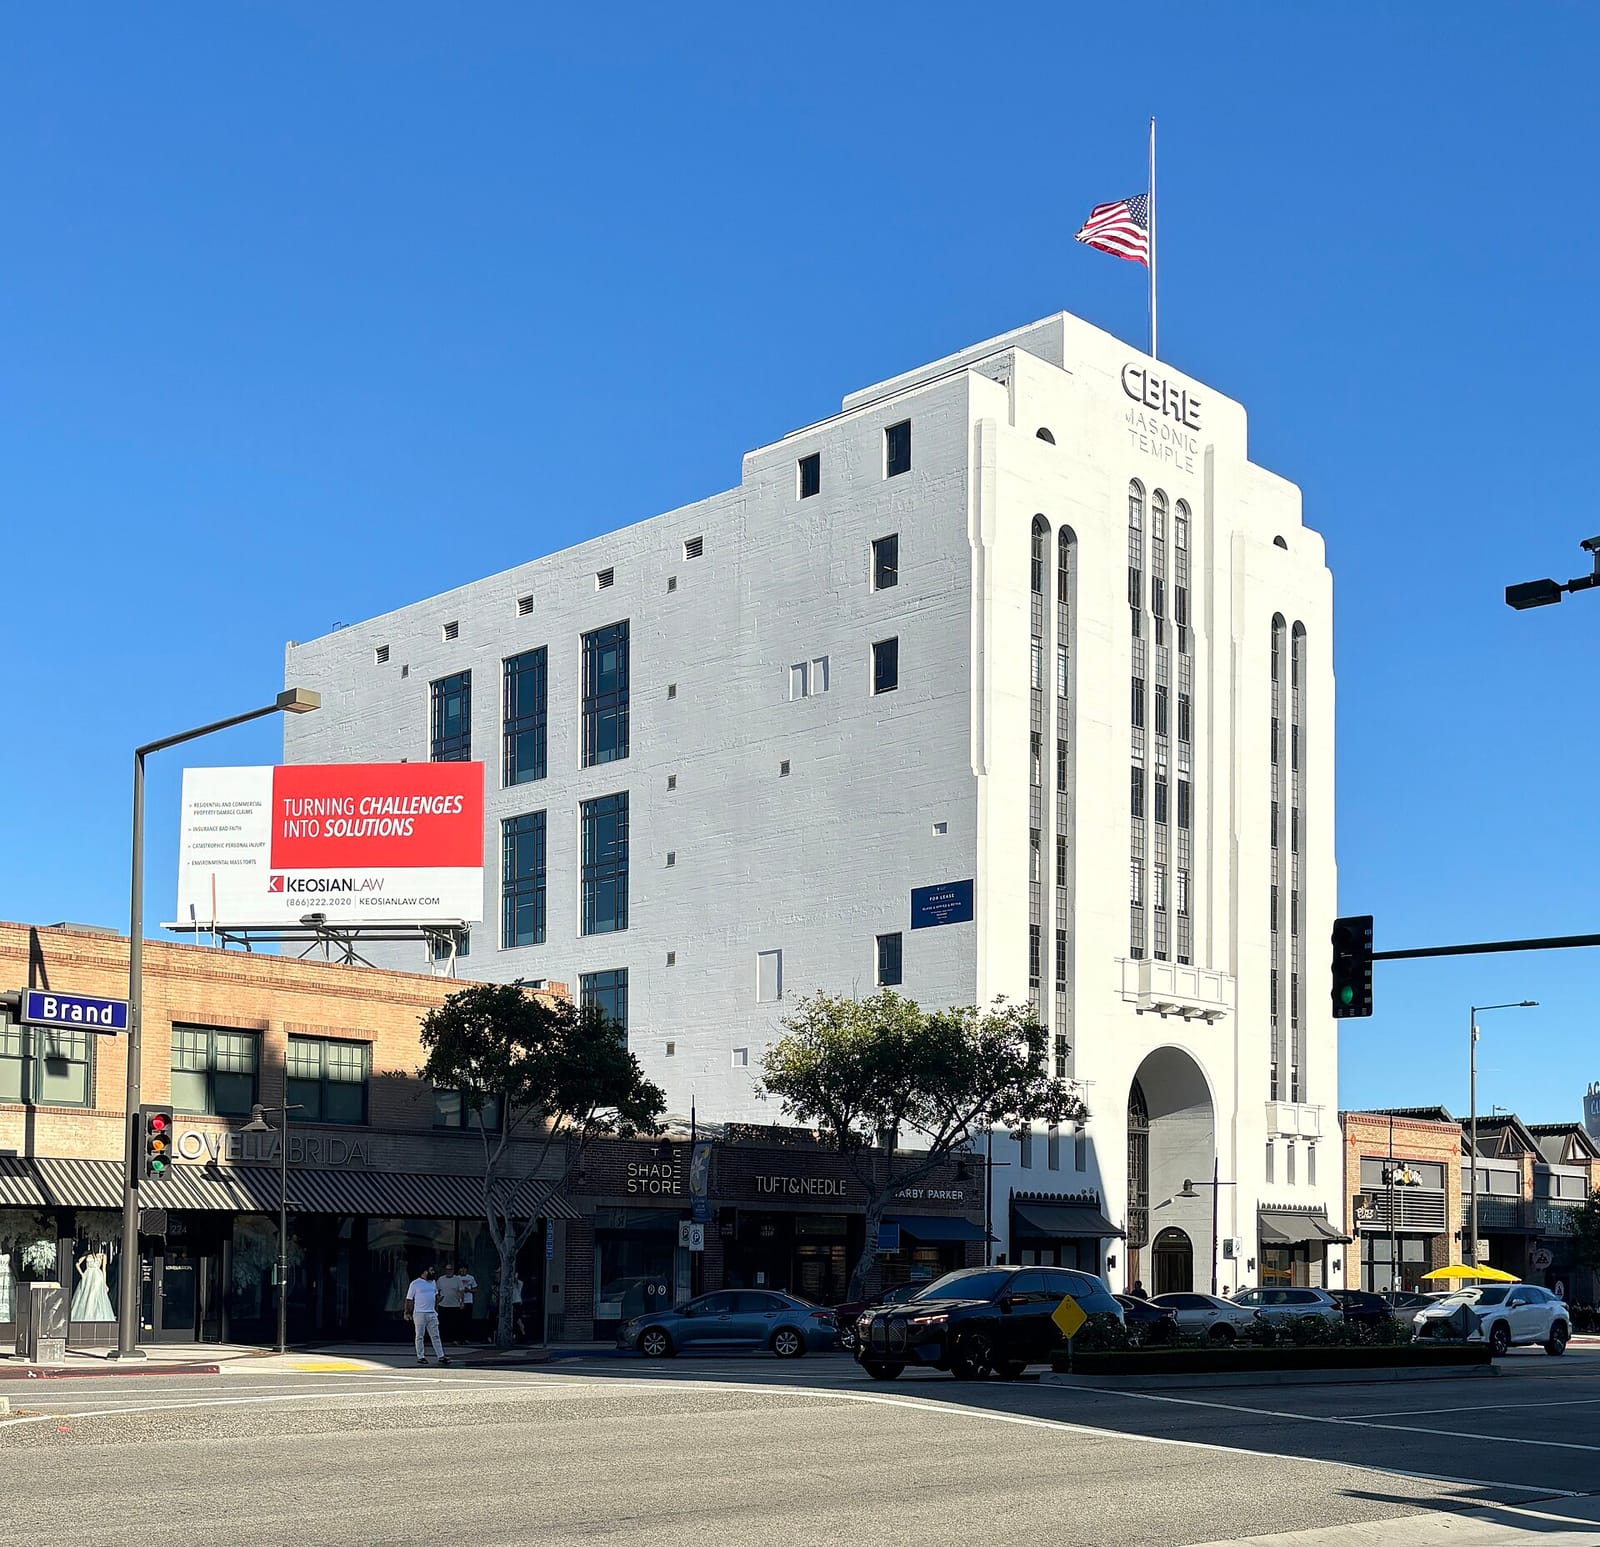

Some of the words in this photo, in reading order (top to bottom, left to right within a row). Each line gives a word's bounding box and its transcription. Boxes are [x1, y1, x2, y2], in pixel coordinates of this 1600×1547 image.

[1121, 362, 1202, 431] CBRE
[1128, 428, 1194, 474] TEMPLE
[283, 797, 355, 817] TURNING
[359, 794, 464, 815] CHALLENGES
[283, 819, 320, 838] INTO
[323, 817, 414, 838] SOLUTIONS
[286, 898, 352, 907] (866)222.2020
[359, 897, 440, 905] KEOSIANLAW.COM
[43, 997, 113, 1024] Brand
[172, 1130, 282, 1162] OVELLA
[288, 1136, 376, 1167] BRIDAL
[651, 1148, 681, 1157] TE
[627, 1162, 681, 1178] SHADE
[627, 1179, 681, 1194] STORE
[755, 1176, 847, 1195] TUFT&NEEDLE
[894, 1188, 923, 1199] ARBY
[927, 1190, 963, 1200] PARKER
